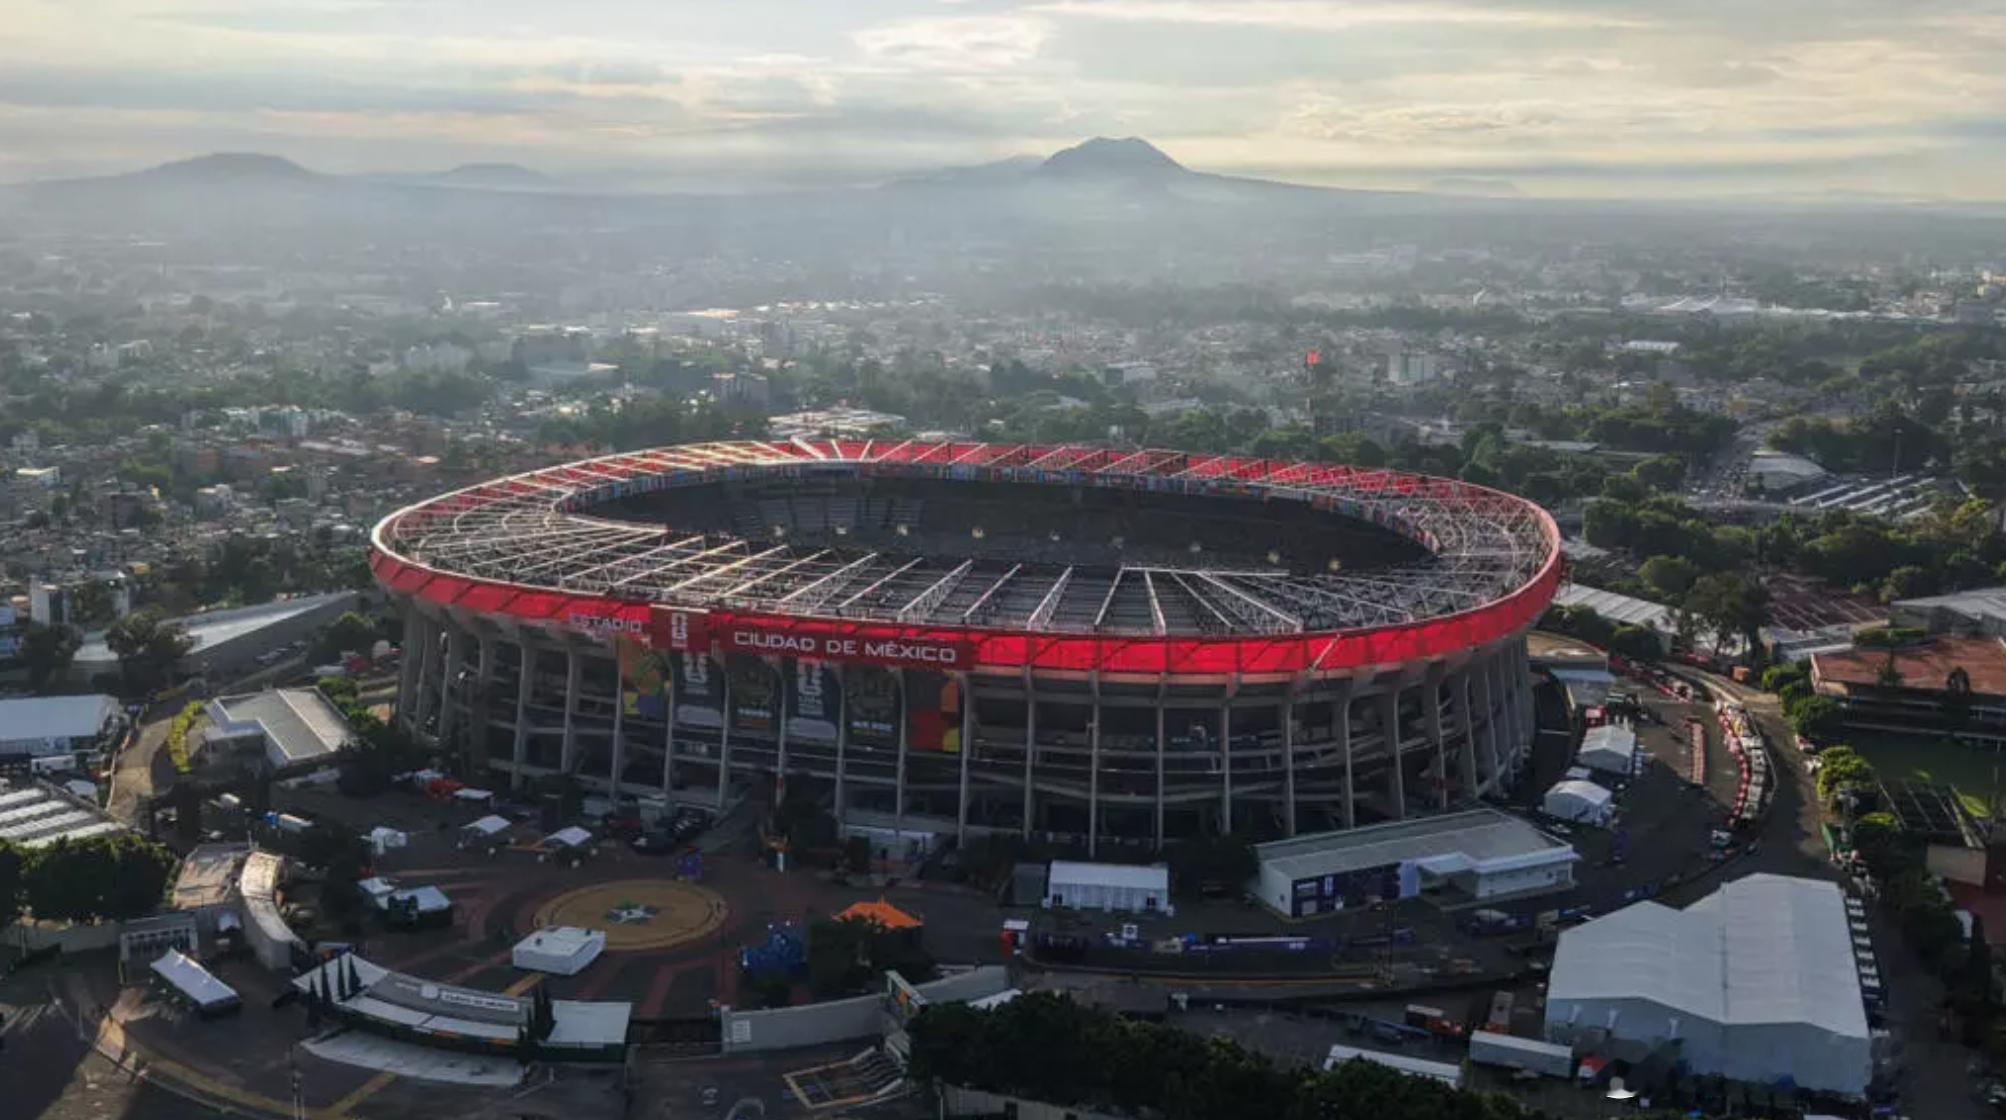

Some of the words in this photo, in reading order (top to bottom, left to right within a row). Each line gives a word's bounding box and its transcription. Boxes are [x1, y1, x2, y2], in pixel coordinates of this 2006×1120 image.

[568, 613, 643, 633] ESTADIO
[733, 630, 815, 652] CIUDAD
[826, 640, 857, 655] DE
[864, 640, 957, 663] MÉXICO
